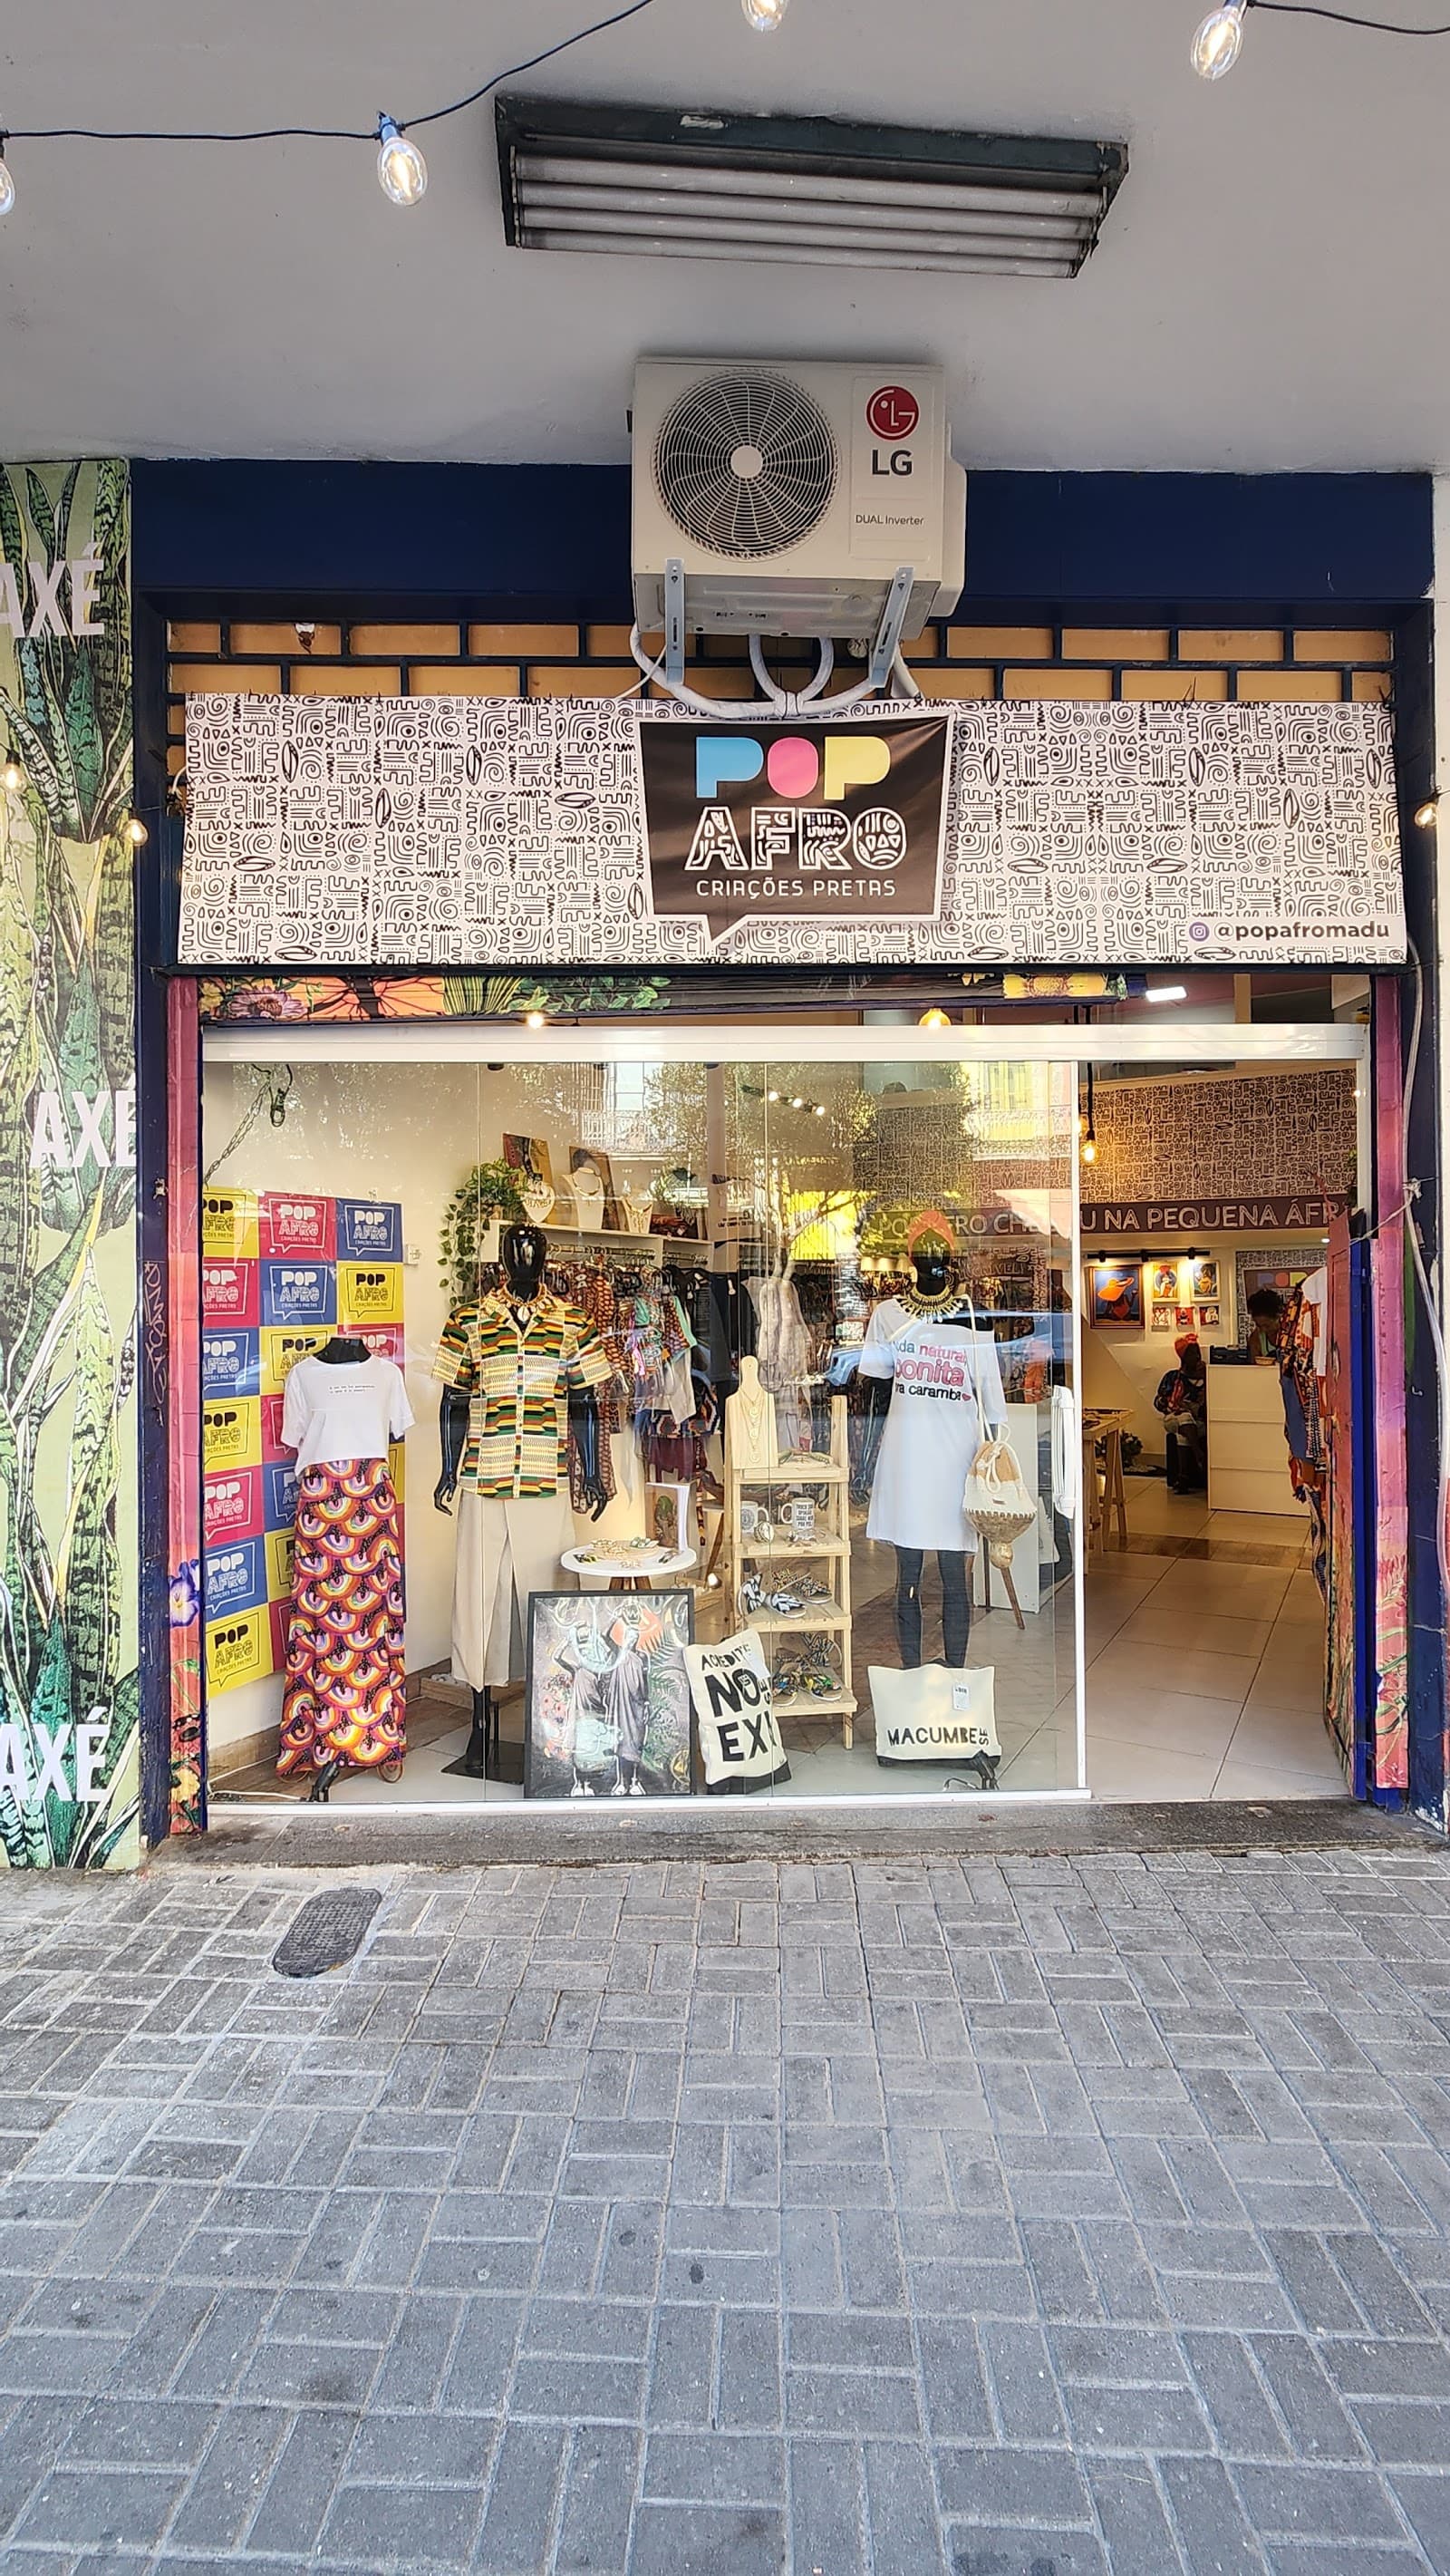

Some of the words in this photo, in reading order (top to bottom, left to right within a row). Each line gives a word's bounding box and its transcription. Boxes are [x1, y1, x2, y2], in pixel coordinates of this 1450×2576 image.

[871, 449, 913, 476] LG
[856, 514, 883, 524] DUAL
[884, 514, 923, 526] Inverter
[696, 736, 891, 800] POP
[684, 806, 907, 870] AFRO
[696, 877, 804, 900] CRIAÇÕES
[813, 879, 895, 896] PRETAS
[1214, 921, 1389, 941] @popafromadu
[280, 1204, 316, 1221] POP
[354, 1210, 385, 1225] POP
[1105, 1208, 1140, 1231] NA
[1147, 1204, 1279, 1230] PEQUENA
[279, 1220, 318, 1236] AFRO
[353, 1225, 388, 1240] AFRO
[281, 1271, 317, 1286] POP
[356, 1273, 386, 1286] POP
[279, 1286, 320, 1303] AFRO
[354, 1287, 389, 1302] AFRO
[282, 1337, 317, 1352] POP
[205, 1481, 240, 1503] POP
[205, 1497, 244, 1521] AFRO
[207, 1552, 245, 1576] POP
[208, 1568, 247, 1595] AFRO
[214, 1623, 248, 1649] POP
[215, 1640, 253, 1668] AFRO
[0, 1706, 110, 1802] AXÉ
